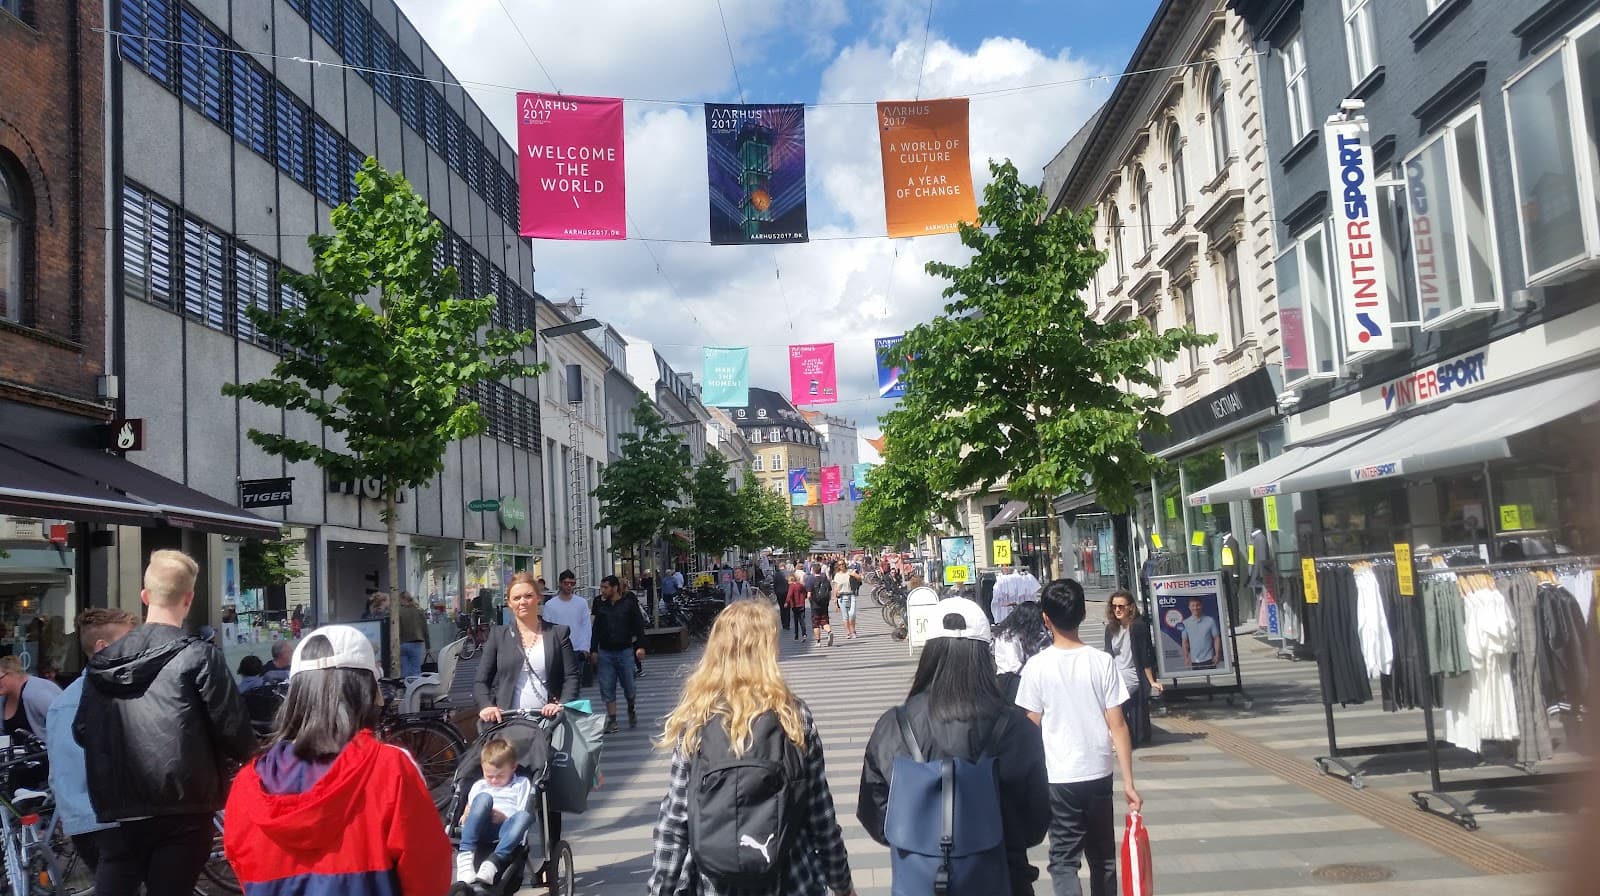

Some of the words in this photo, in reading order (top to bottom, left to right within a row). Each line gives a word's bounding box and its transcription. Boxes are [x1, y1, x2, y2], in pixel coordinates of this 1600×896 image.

[523, 98, 578, 111] AARHUS
[883, 105, 929, 117] AARHUS
[523, 109, 551, 119] 2017
[711, 108, 762, 119] AARHUS
[711, 119, 737, 129] 2017
[883, 116, 906, 127] 2017
[527, 144, 616, 161] WELCOME
[890, 143, 896, 153] A
[900, 140, 941, 152] WORLD
[945, 139, 960, 149] OF
[900, 151, 950, 164] CULTURE
[555, 162, 589, 177] THE
[540, 177, 604, 193] WORLD
[908, 177, 914, 187] A
[918, 175, 947, 186] YEAR
[896, 188, 910, 199] OF
[915, 185, 960, 198] CHANGE
[1337, 134, 1379, 308] INTERSPORT
[1396, 352, 1485, 406] INTERSPORT
[1210, 391, 1243, 419] NEXTMAN
[243, 491, 291, 503] TIGER
[1164, 578, 1217, 589] INTERSPORT
